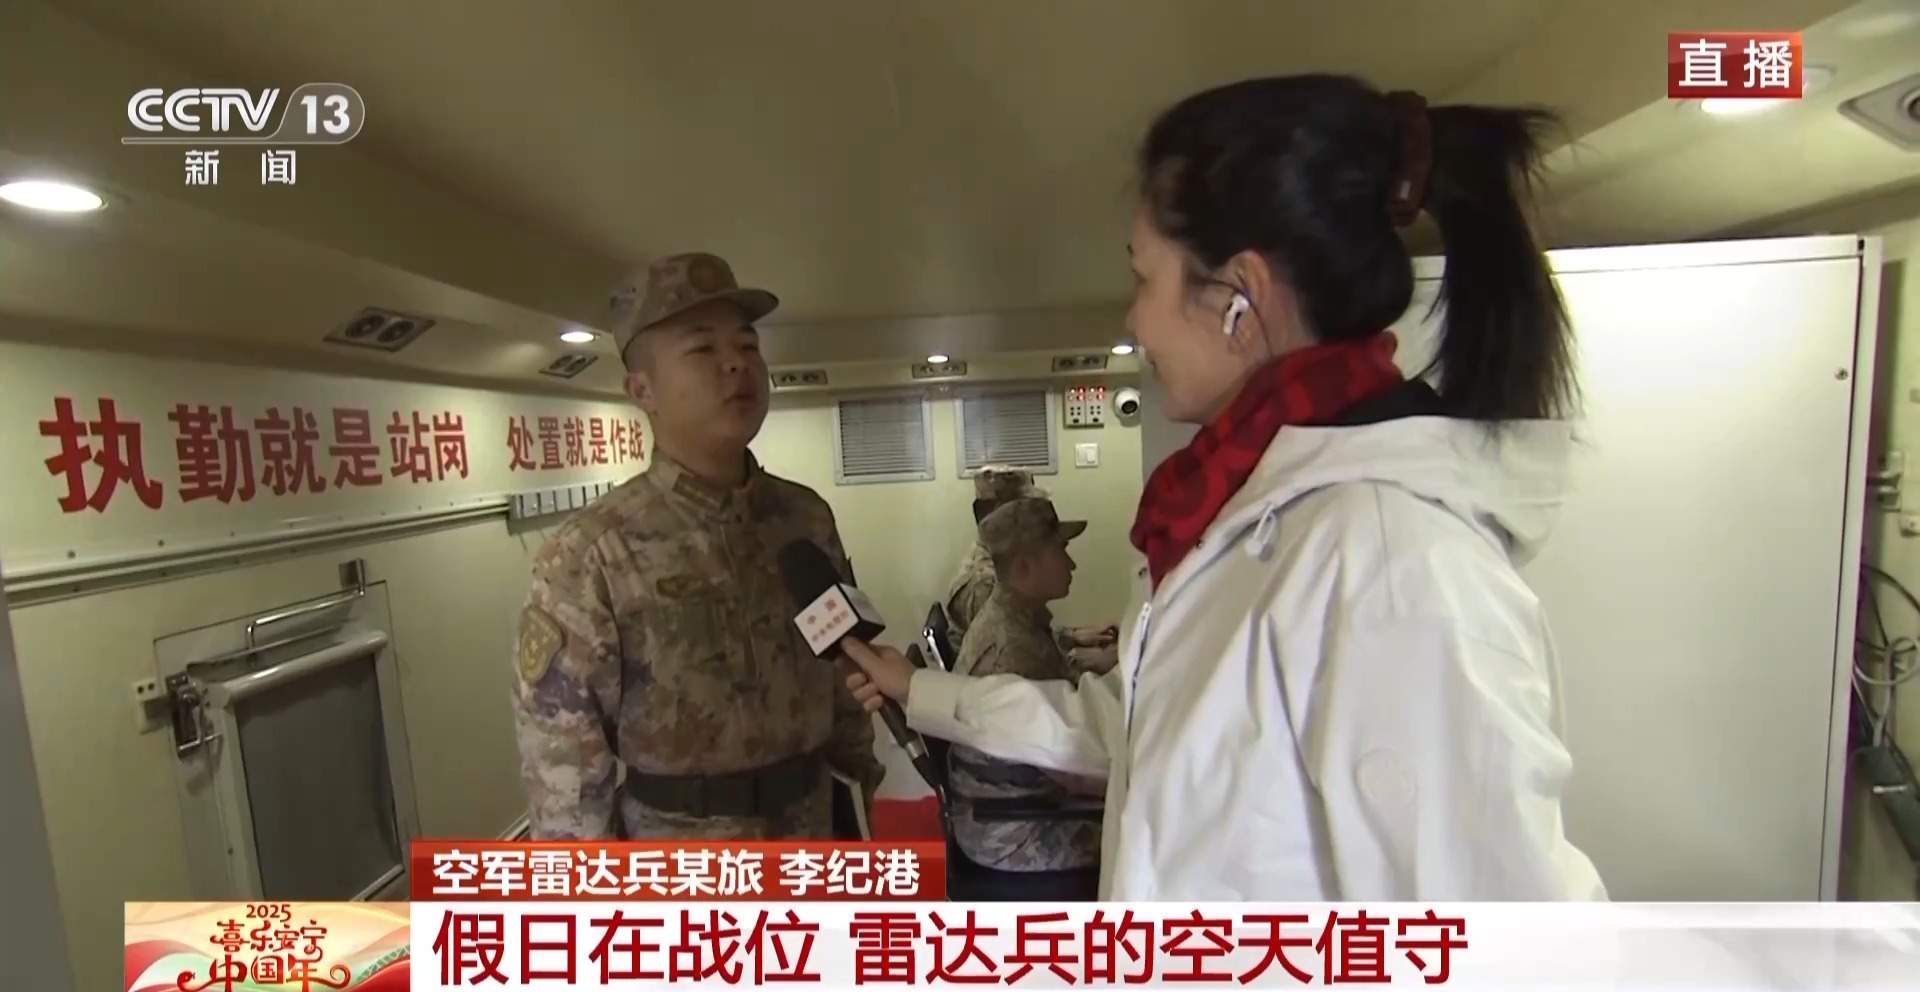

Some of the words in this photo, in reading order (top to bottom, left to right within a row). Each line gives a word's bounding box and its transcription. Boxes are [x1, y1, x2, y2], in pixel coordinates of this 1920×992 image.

[39, 396, 470, 514] 执勤就是站岗
[506, 415, 645, 472] 处置就是作战
